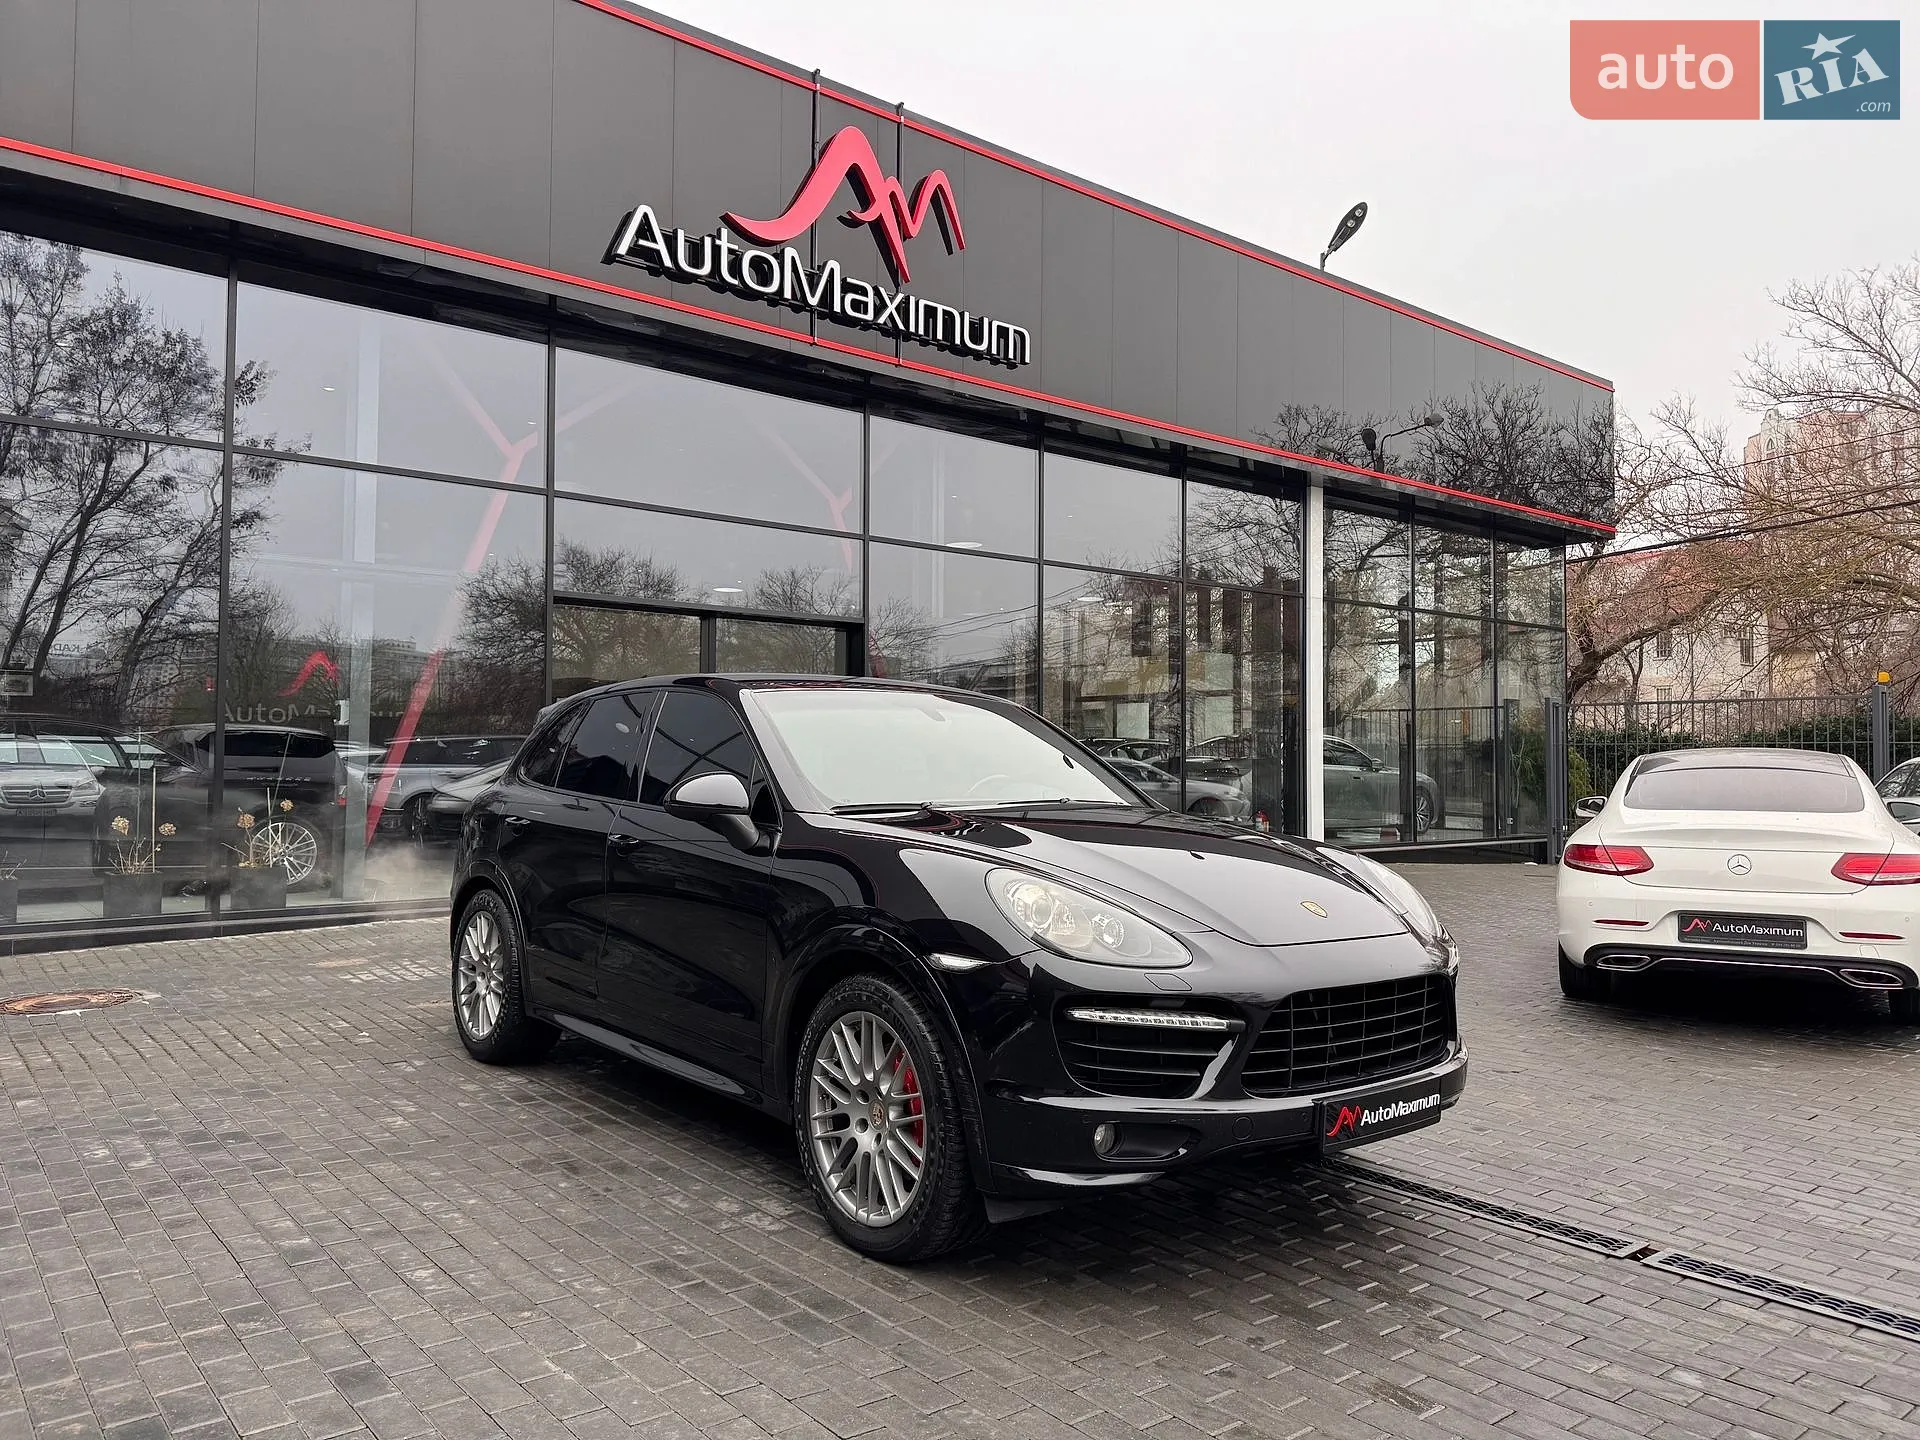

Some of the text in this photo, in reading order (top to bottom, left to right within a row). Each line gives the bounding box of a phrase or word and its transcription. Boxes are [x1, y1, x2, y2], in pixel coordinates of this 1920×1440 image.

[614, 203, 1032, 365] AutoMaximum
[1712, 923, 1803, 937] AutoMaximum
[1360, 1093, 1441, 1127] AutoMaximum
